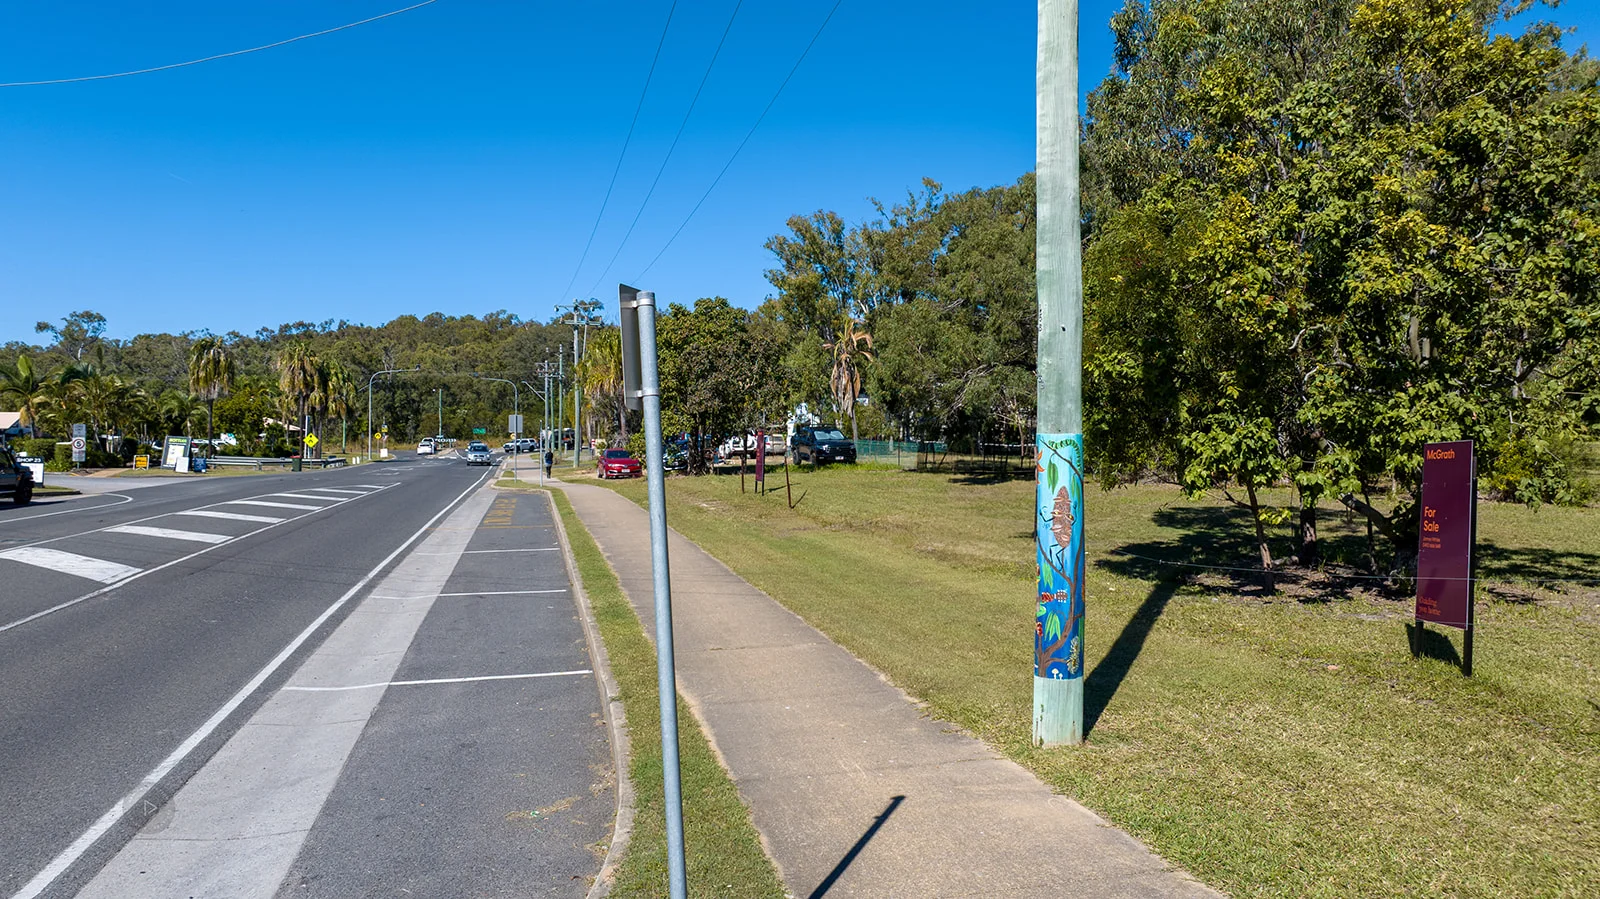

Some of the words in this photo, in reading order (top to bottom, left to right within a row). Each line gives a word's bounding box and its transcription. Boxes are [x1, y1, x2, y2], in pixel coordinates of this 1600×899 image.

[1426, 449, 1455, 460] McGrath
[1424, 506, 1436, 518] For
[1423, 520, 1440, 532] Sale
